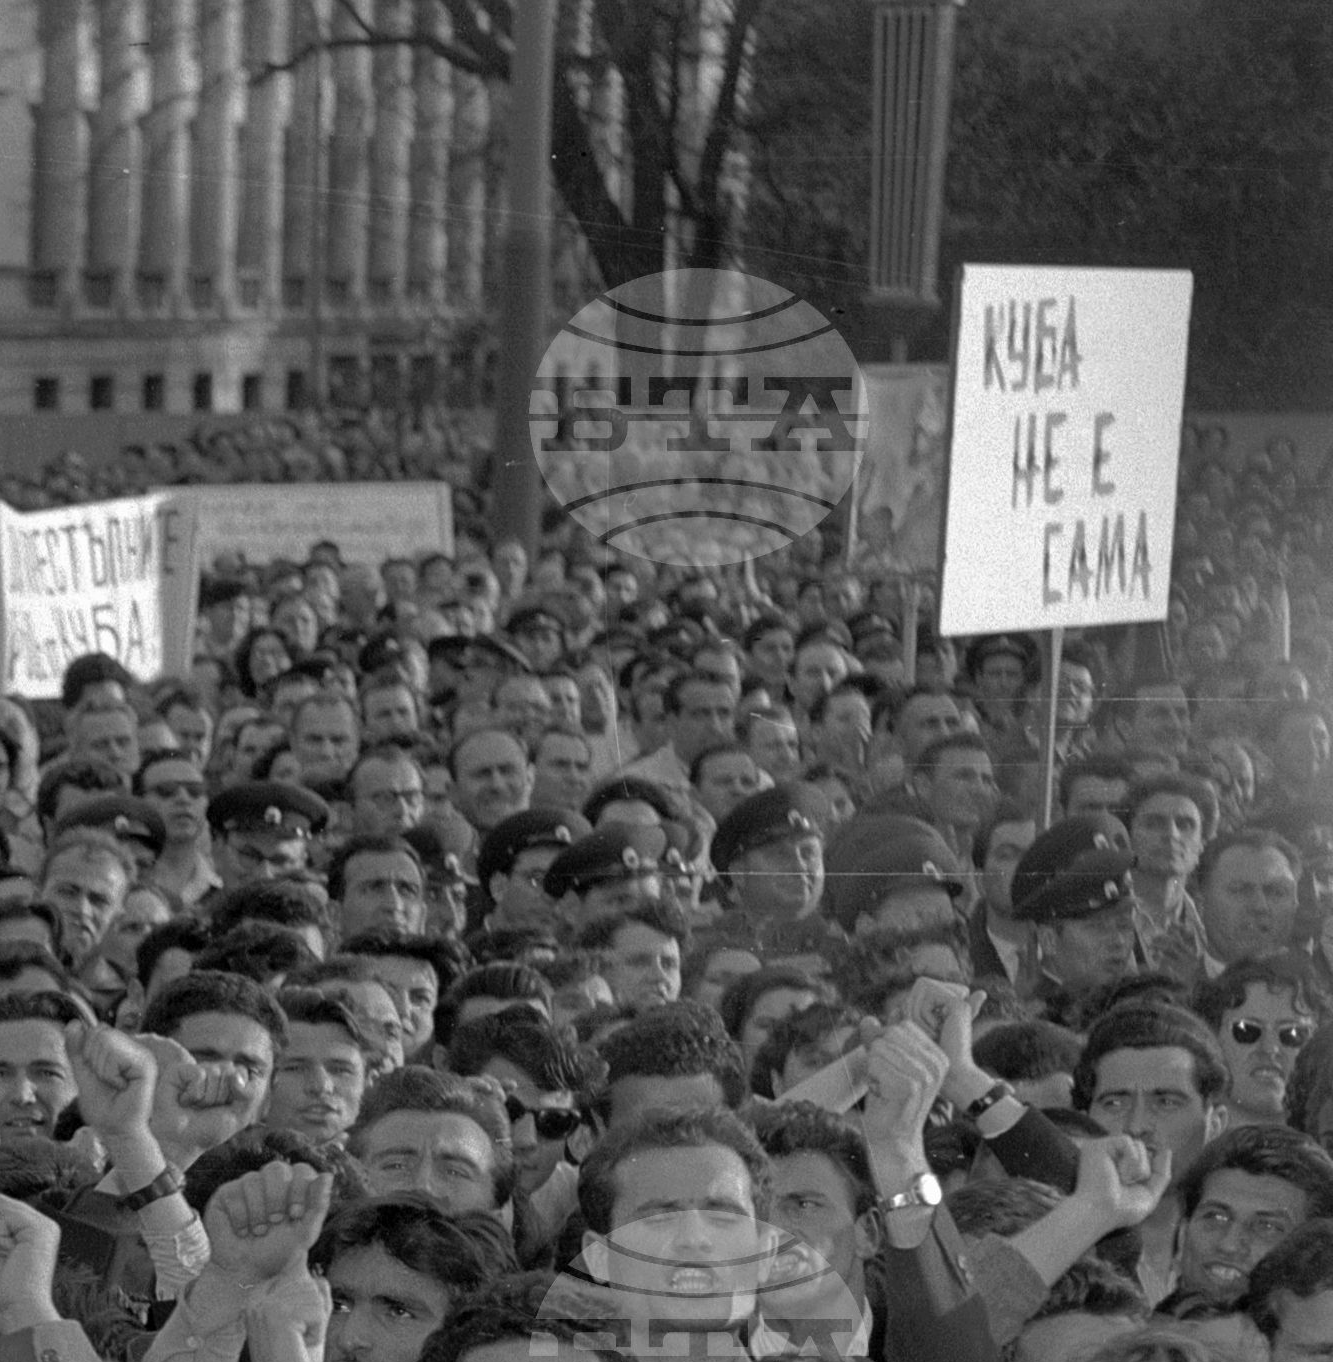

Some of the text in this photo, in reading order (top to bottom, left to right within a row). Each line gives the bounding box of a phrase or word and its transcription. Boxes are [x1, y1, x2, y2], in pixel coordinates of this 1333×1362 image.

[984, 295, 1082, 393] КУБА
[1011, 410, 1116, 510] НЕ Е
[1042, 509, 1152, 607] САМА
